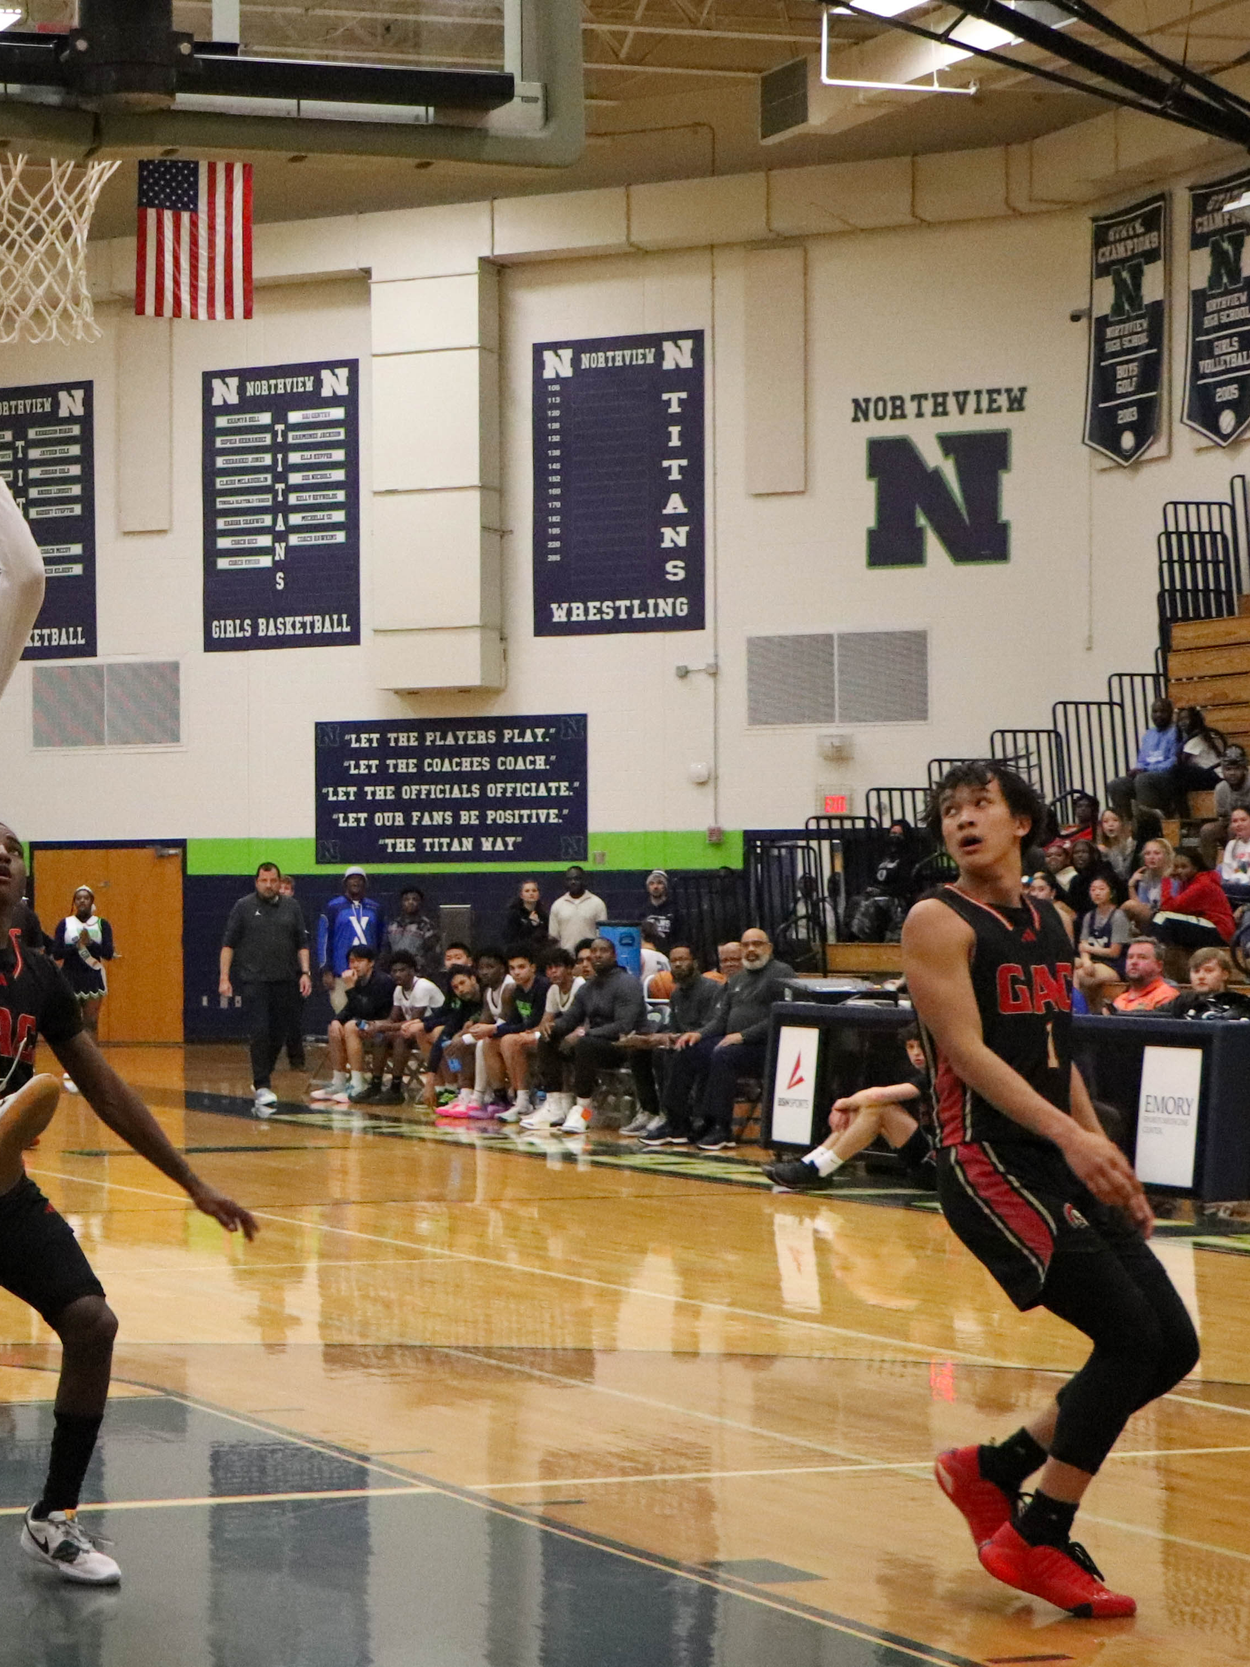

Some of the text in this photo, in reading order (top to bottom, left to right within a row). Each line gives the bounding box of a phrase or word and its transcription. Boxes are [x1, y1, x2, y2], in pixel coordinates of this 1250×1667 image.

[1213, 336, 1239, 355] GIRLS
[543, 339, 693, 379] N NORTHVIEW N
[212, 368, 349, 406] N NORTHVIEW N
[58, 389, 85, 418] N
[852, 386, 1027, 422] NORTHVIEW
[866, 428, 1012, 570] N
[550, 597, 688, 622] WRESTLING
[212, 614, 350, 638] GIRLS BASKETBALL
[387, 732, 418, 746] THE
[425, 730, 496, 745] PLAYERS
[386, 759, 417, 773] THE
[424, 757, 491, 772] COACHES
[364, 785, 395, 799] THE
[402, 784, 480, 799] OFFICIALS
[824, 796, 847, 813] EXIT
[374, 812, 405, 826] OUR
[411, 811, 453, 825] FANS
[460, 811, 479, 825] BE
[423, 837, 473, 851] TITAN
[1144, 1094, 1194, 1116] EMORY
